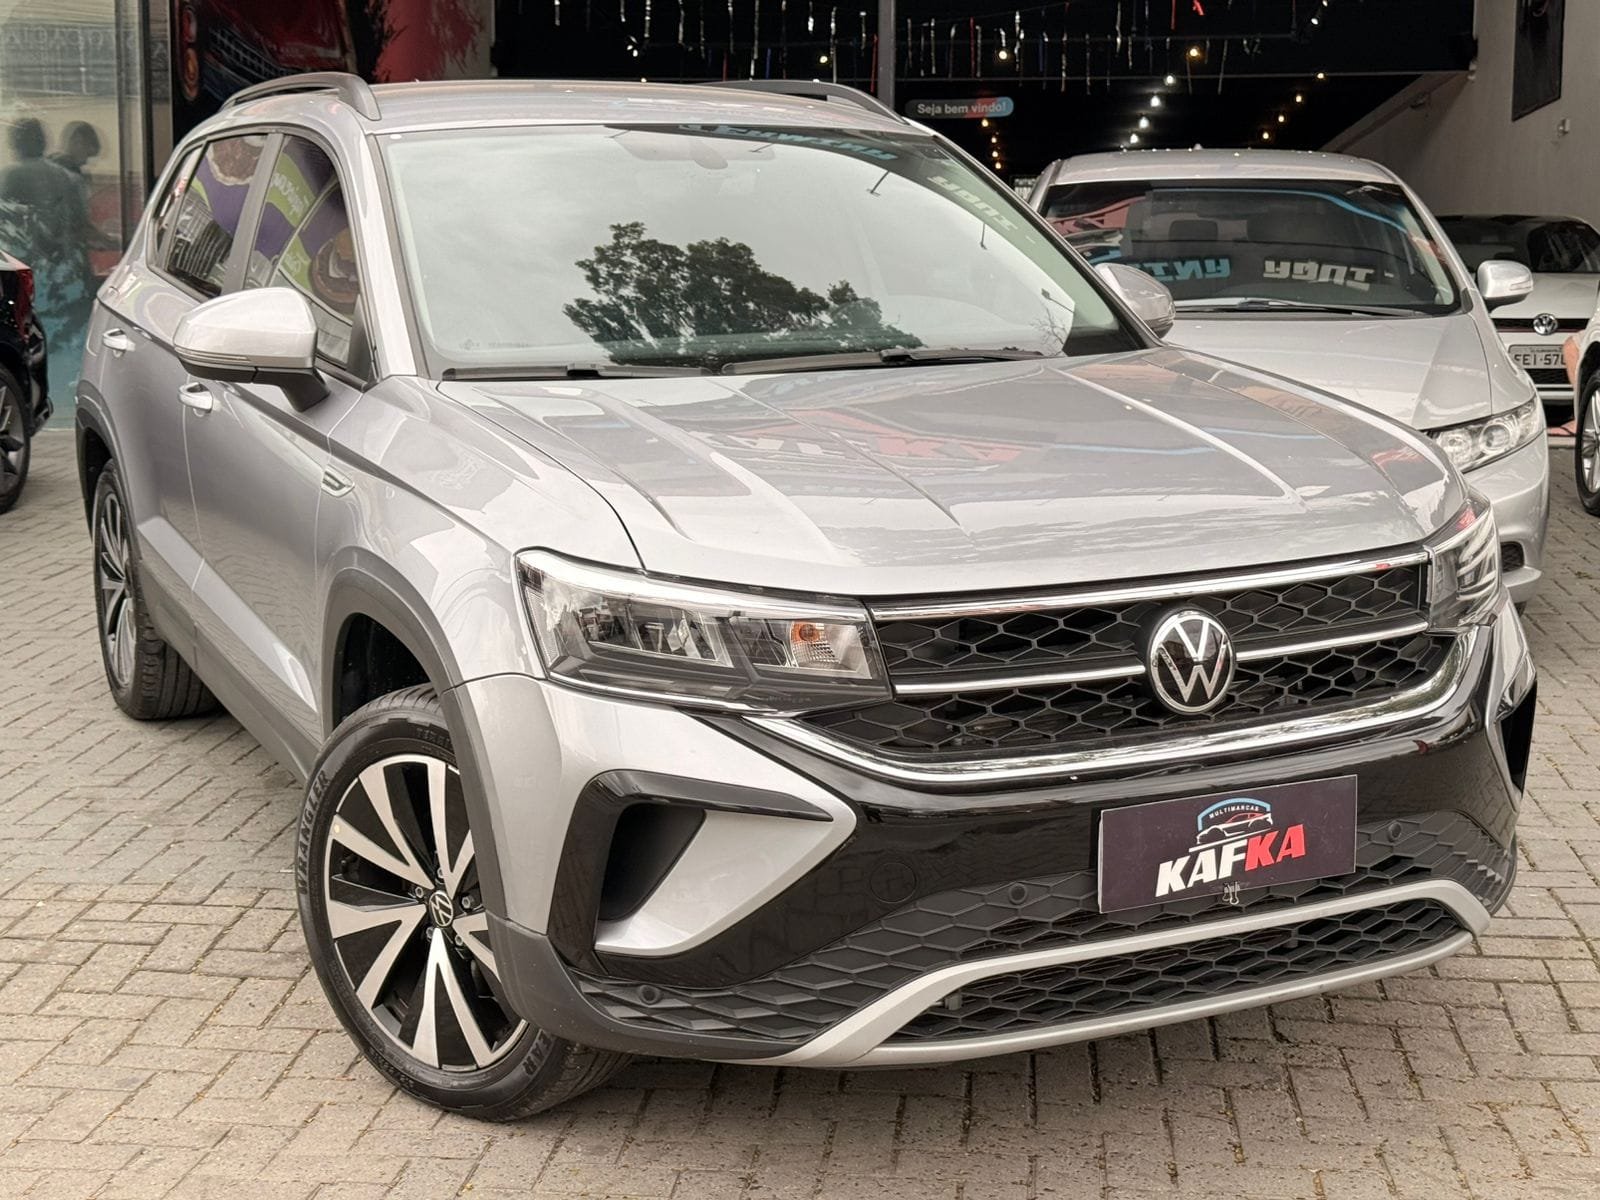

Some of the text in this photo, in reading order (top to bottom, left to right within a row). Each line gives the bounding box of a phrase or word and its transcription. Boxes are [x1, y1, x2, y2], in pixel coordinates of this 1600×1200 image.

[917, 102, 1006, 116] Seja bem vindo!
[297, 769, 331, 896] WRANGLER
[1208, 805, 1260, 819] MULTIMARCAS
[1155, 824, 1307, 897] KAFKA
